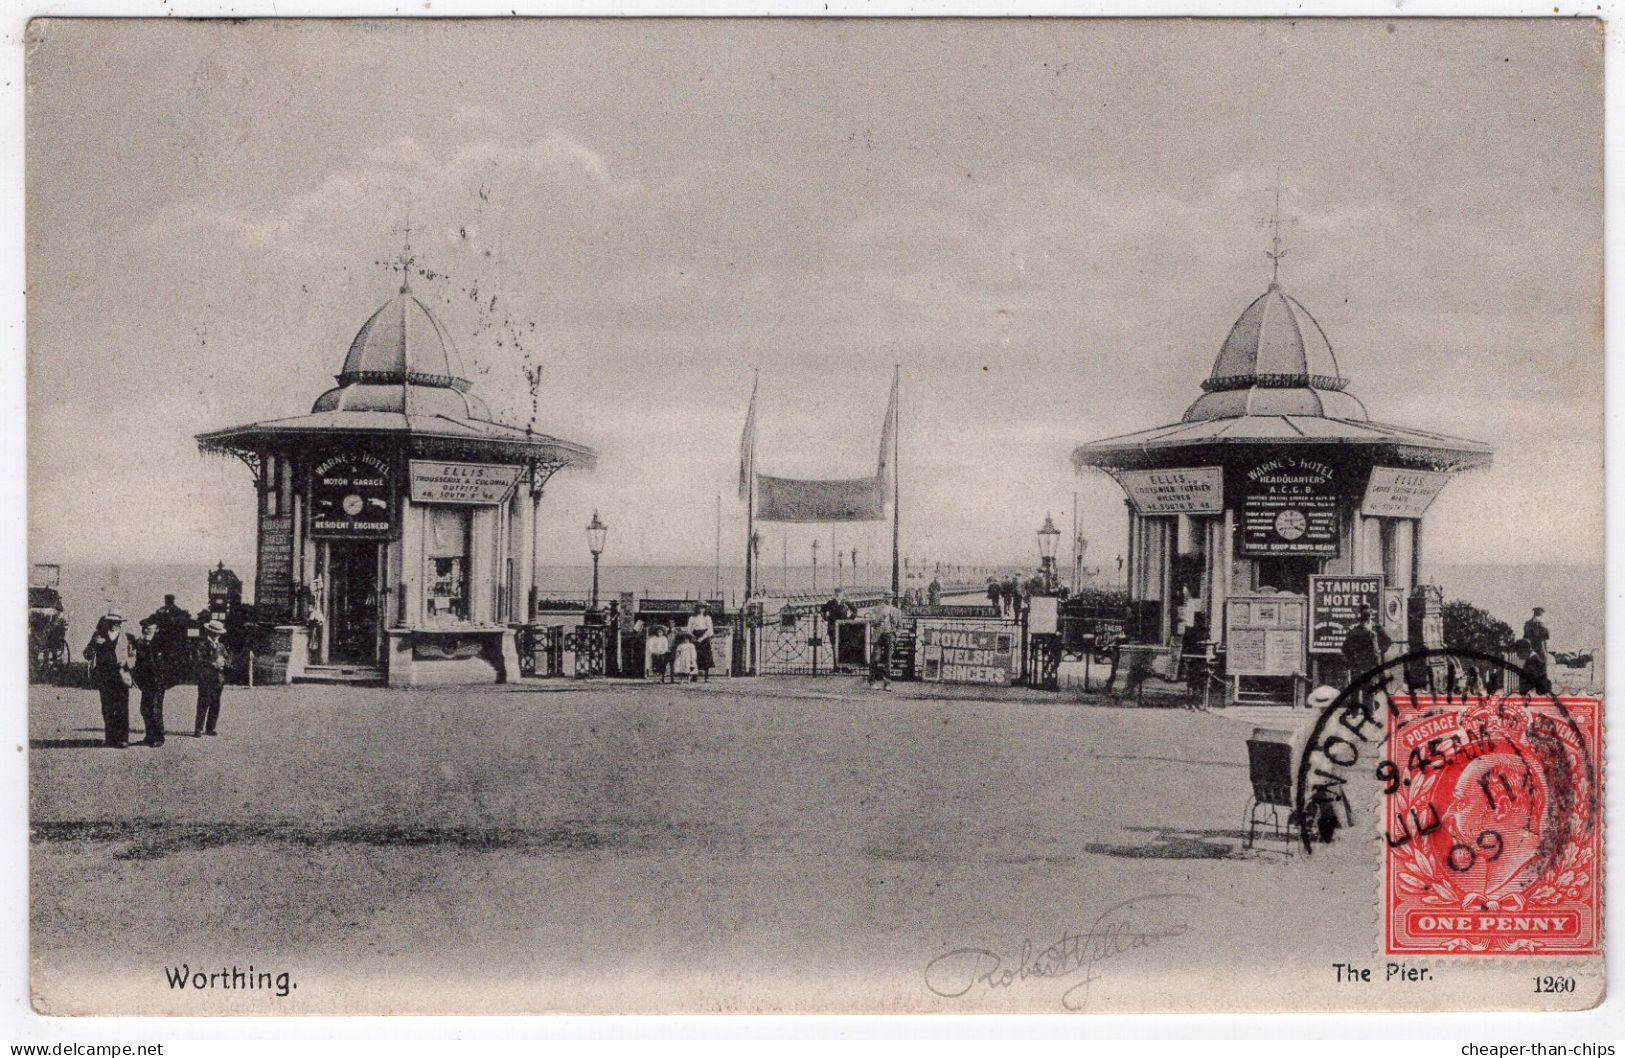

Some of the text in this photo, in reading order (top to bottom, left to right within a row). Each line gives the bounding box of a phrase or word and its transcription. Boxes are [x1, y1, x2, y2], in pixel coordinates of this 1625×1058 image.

[362, 451, 390, 476] HOTEL
[1300, 458, 1335, 480] HOTEL
[324, 478, 348, 486] MOTOR
[475, 479, 509, 487] COLONIAL
[1260, 475, 1326, 484] HEADQUARTERS
[315, 521, 389, 530] RESIDENT ENGINEER
[1316, 581, 1378, 593] STANHOE
[1323, 594, 1371, 607] HOTEL
[930, 631, 978, 648] ROYAL
[942, 649, 994, 666] WELSH
[942, 664, 1005, 682] SINGERS
[1406, 715, 1456, 746] POSTAGE
[1418, 917, 1569, 931] ONE PENNY
[165, 964, 298, 997] Worthing.
[1332, 962, 1433, 983] The Pier.
[1533, 975, 1576, 993] 1260
